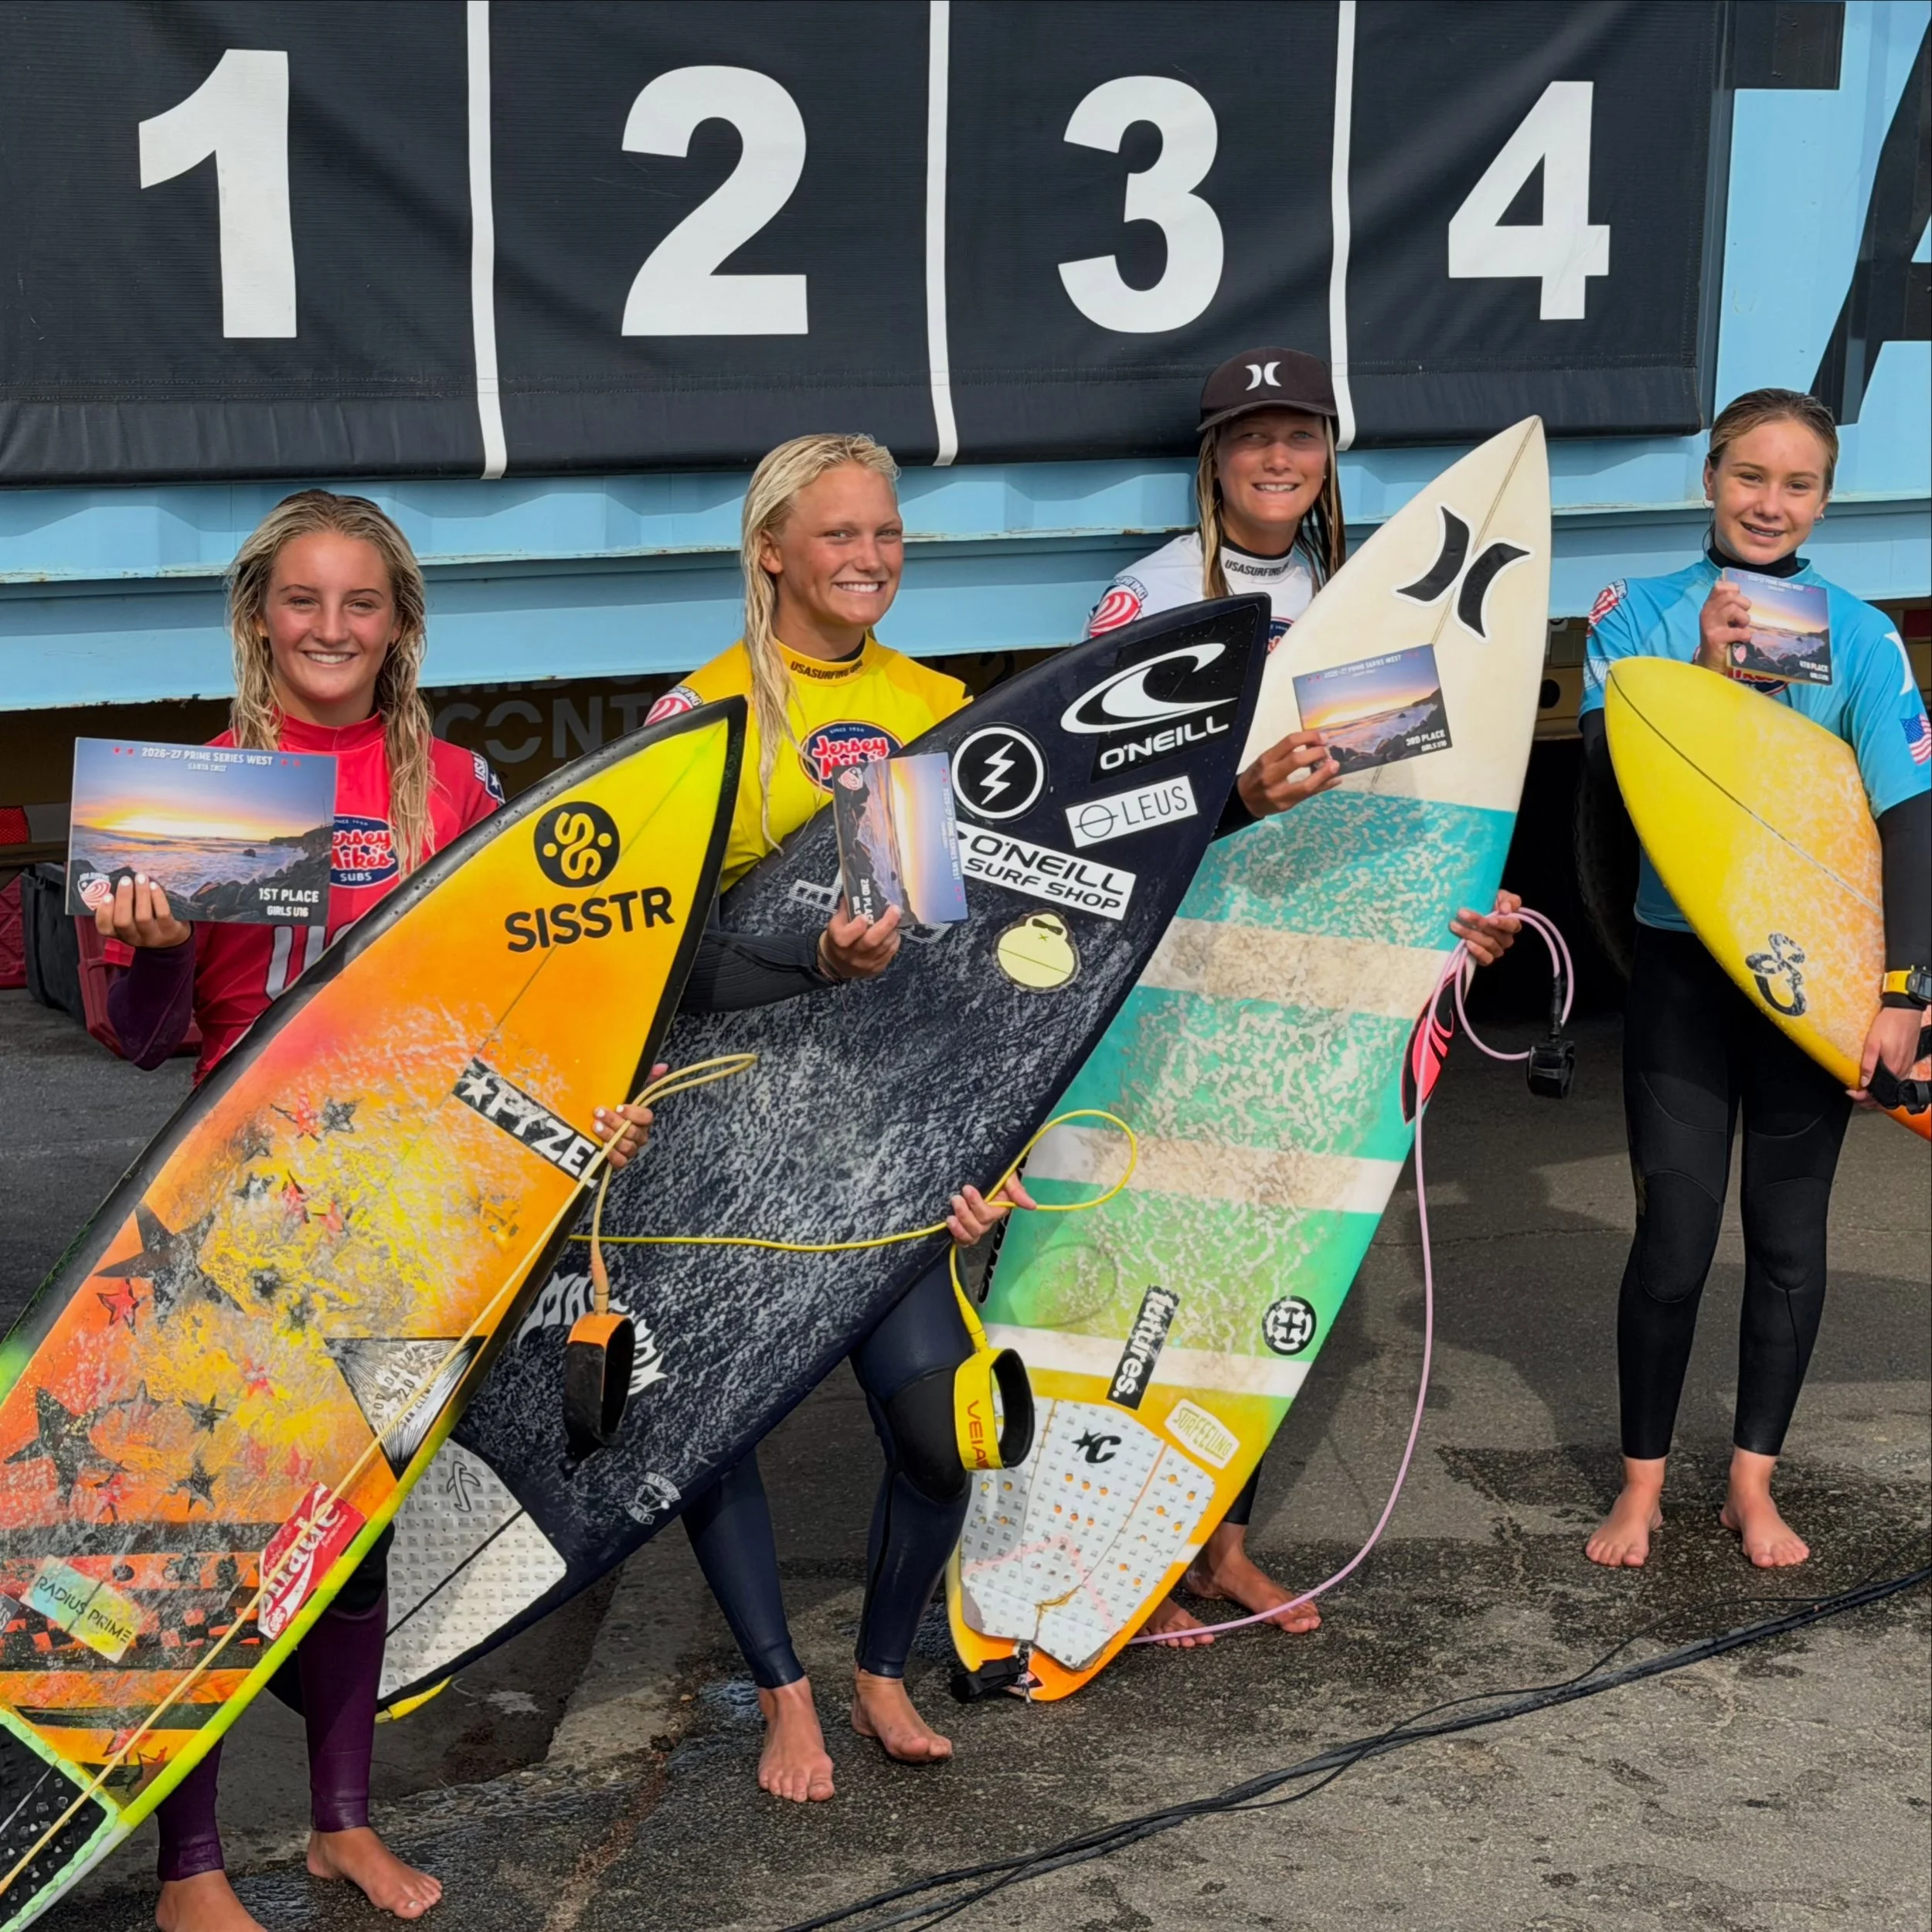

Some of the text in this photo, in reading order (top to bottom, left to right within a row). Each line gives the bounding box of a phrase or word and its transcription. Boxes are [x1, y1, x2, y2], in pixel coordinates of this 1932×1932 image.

[139, 49, 296, 338] 1
[621, 66, 808, 335] 2
[1059, 76, 1223, 332] 3
[1449, 81, 1610, 320] 4
[142, 747, 273, 766] 2026-27 PRIME SERIES WEST
[812, 736, 889, 757] Jersey
[1100, 716, 1229, 770] O'NEILL
[1422, 730, 1445, 742] PLACE
[1121, 786, 1188, 825] LEUS
[332, 829, 393, 852] ersey
[970, 835, 1124, 896] O'NEILL
[259, 888, 319, 903] 1ST PLACE
[340, 872, 372, 882] SUBS
[964, 858, 1121, 909] SURF SHOP
[267, 905, 308, 917] GIRLS U16
[505, 886, 675, 952] SISSTR
[36, 1576, 87, 1615] RADIUS
[87, 1609, 133, 1644] PRIME
